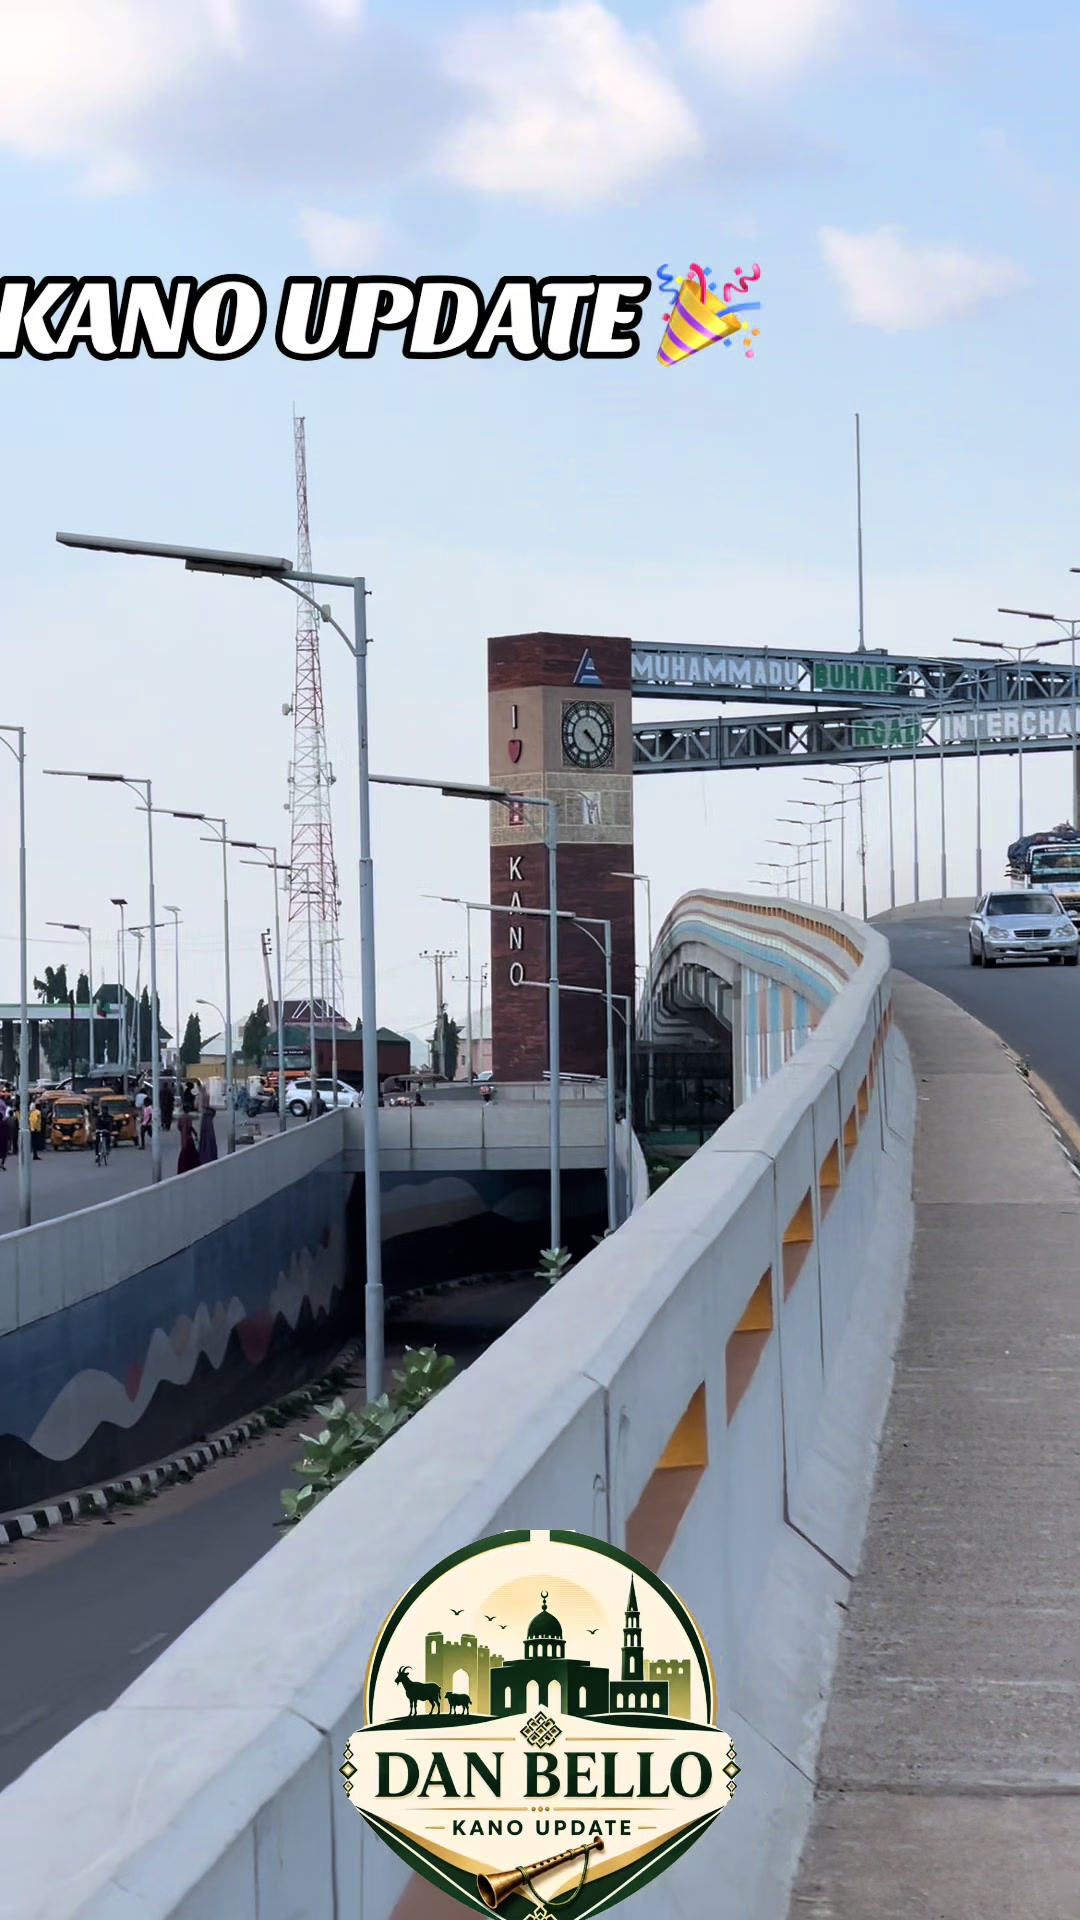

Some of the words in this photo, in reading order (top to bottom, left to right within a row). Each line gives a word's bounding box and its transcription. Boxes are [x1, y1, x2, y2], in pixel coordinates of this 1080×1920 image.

[632, 653, 799, 686] MUHAMMADU
[854, 718, 921, 746] ROAD
[509, 856, 524, 986] KANO
